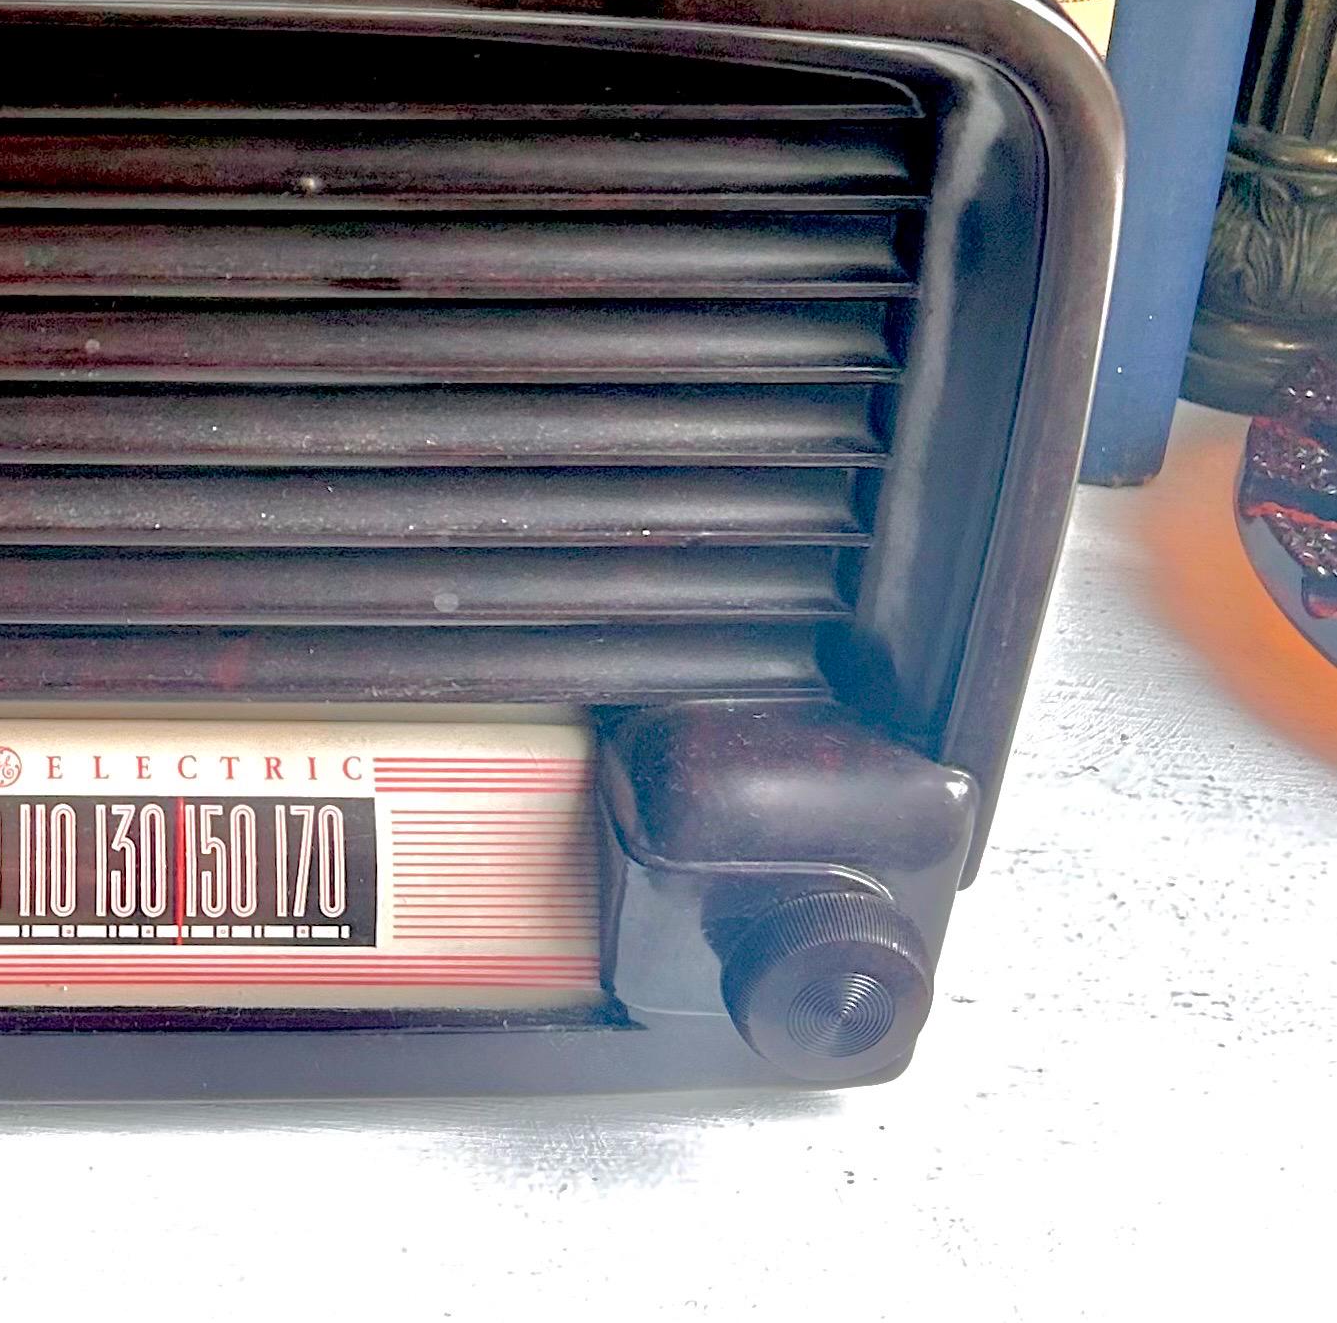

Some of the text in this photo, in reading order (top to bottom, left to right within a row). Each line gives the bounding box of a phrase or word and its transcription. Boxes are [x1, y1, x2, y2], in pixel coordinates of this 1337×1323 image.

[46, 755, 363, 780] ELECTRIC
[19, 803, 76, 917] 110
[95, 803, 166, 917] 130
[185, 803, 257, 917] 150
[274, 803, 346, 917] 170
